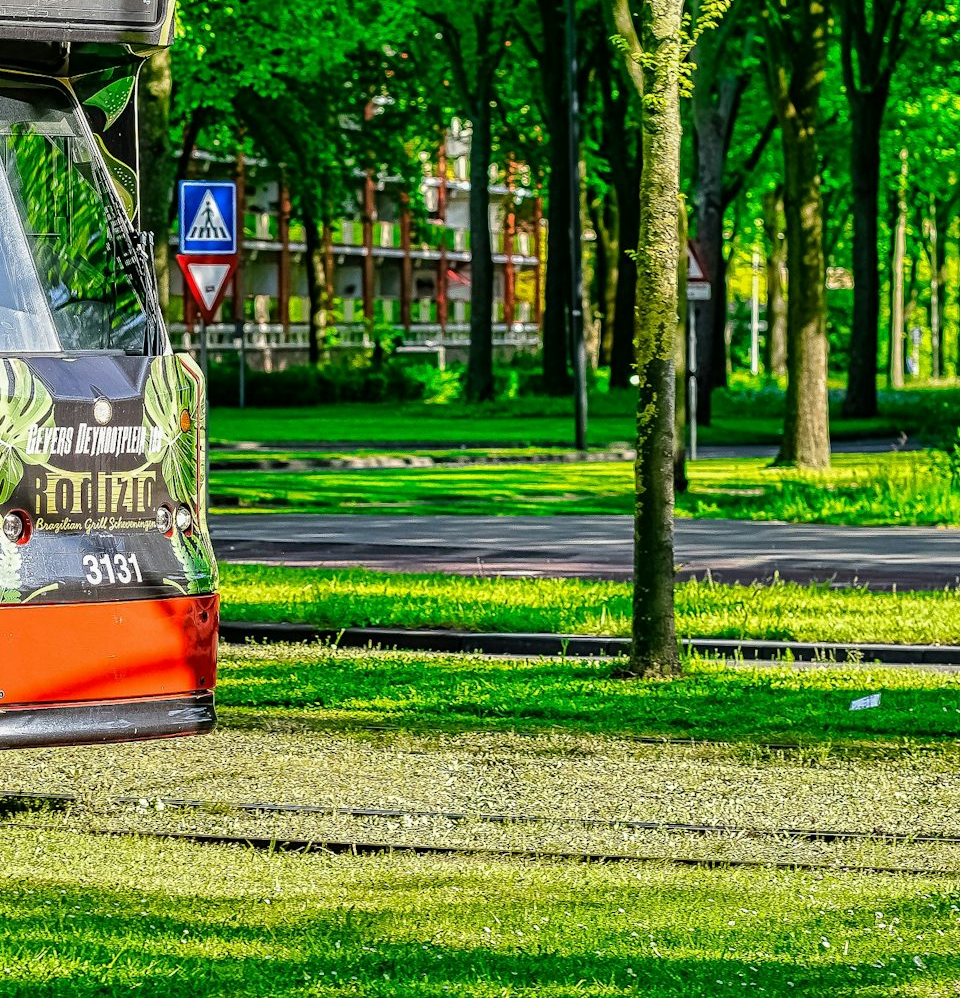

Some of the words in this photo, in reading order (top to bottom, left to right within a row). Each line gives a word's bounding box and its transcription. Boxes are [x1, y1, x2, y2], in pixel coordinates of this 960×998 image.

[35, 517, 83, 533] Brazilian
[84, 517, 108, 534] Grill
[82, 552, 143, 586] 3131
